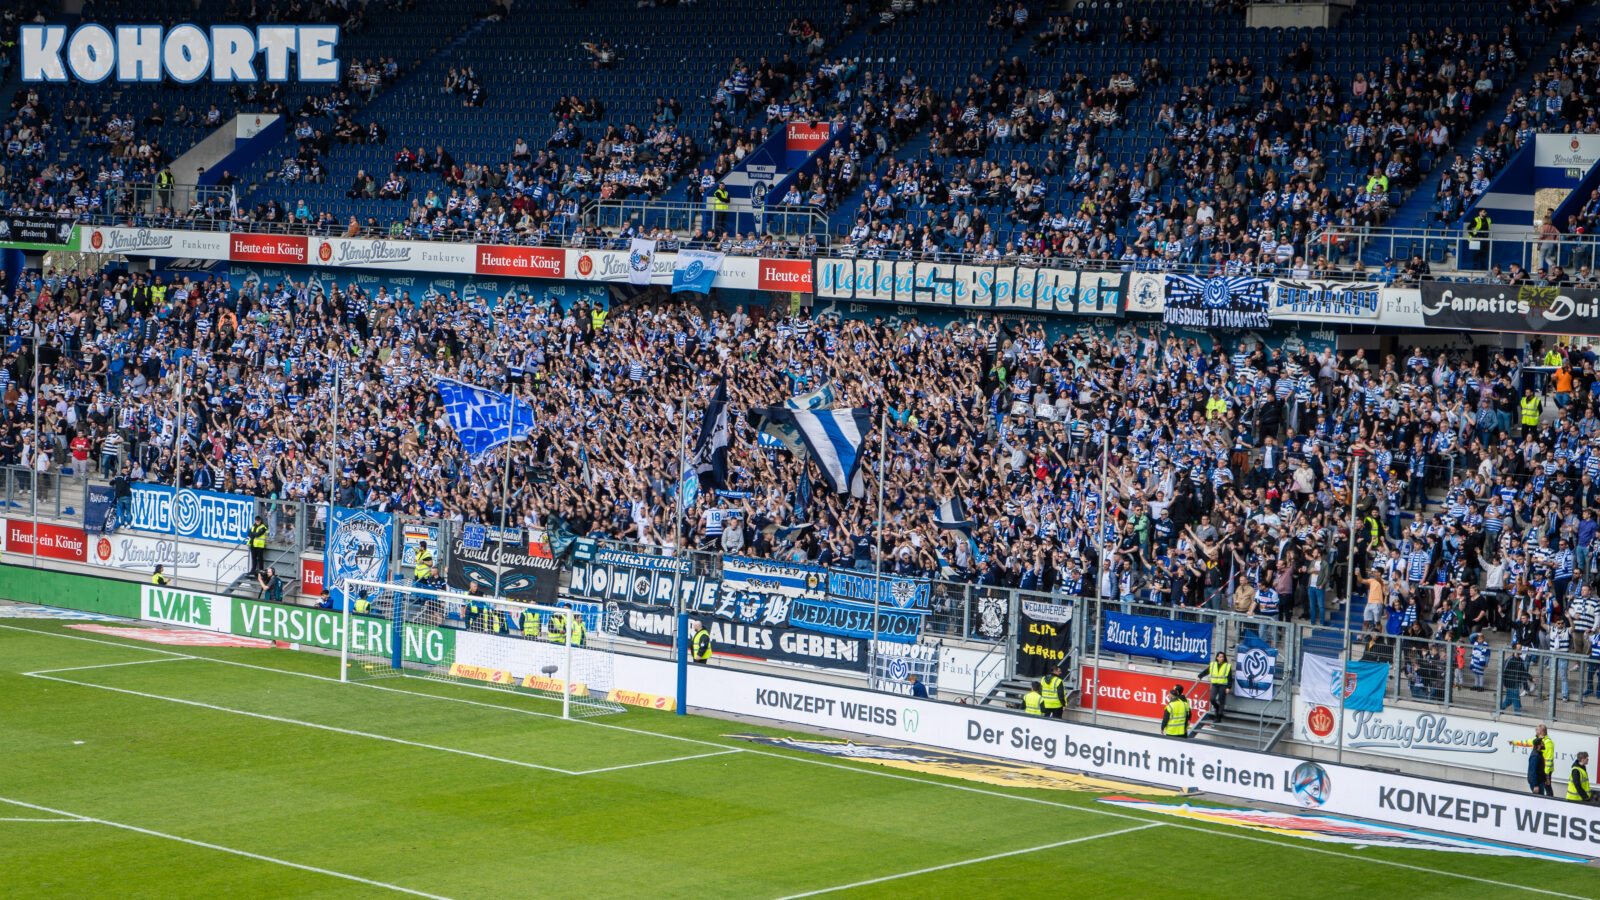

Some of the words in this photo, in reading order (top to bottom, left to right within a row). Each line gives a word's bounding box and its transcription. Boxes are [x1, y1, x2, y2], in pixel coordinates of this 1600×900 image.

[788, 131, 809, 140] Heute
[182, 240, 220, 250] Fankurve
[235, 241, 261, 254] Heute
[261, 243, 276, 255] ein
[277, 243, 304, 260] König
[422, 252, 465, 263] Fankurve
[482, 253, 511, 267] Heute
[513, 256, 528, 268] ein
[530, 256, 561, 275] König
[765, 267, 799, 282] Heute
[801, 268, 812, 283] ei
[818, 262, 967, 297] Meidericher
[976, 271, 1119, 306] Spielverein
[1163, 307, 1209, 327] DUISBURG
[1211, 309, 1270, 328] DYNAMITES
[1386, 301, 1420, 315] Fank
[1422, 290, 1529, 316] Fanatics
[1542, 296, 1600, 322] Dui
[200, 496, 254, 543] TREU
[711, 512, 721, 522] 18
[40, 534, 53, 546] ein
[55, 535, 83, 556] König
[454, 540, 490, 562] Proud
[491, 549, 559, 571] Generation
[829, 571, 893, 604] METROPOL
[914, 583, 930, 608] 47
[149, 588, 192, 624] LVM
[1024, 601, 1067, 617] WEDAUHERDE
[792, 604, 919, 637] WEDAUSTADION
[629, 610, 697, 640] IMMR
[710, 621, 773, 651] ALLES
[779, 632, 860, 663] GEBEN!
[1107, 620, 1138, 648] Block
[1153, 626, 1208, 659] Duisburg
[456, 665, 488, 681] Sinalco
[529, 676, 562, 692] Sinalco
[615, 690, 649, 707] Sinalco
[1085, 679, 1132, 700] Heute
[1134, 685, 1158, 705] ein
[756, 687, 837, 717] KONZEPT
[841, 700, 897, 727] WEISS
[1348, 711, 1415, 748] König
[1410, 712, 1498, 748] Pilsener
[967, 719, 1005, 746] Der
[1010, 726, 1058, 759] Sieg
[1065, 734, 1151, 770] beginnt
[1158, 751, 1195, 778] mit
[1202, 759, 1275, 791] einem
[1379, 786, 1507, 827] KONZEPT
[1515, 807, 1600, 844] WEISS
